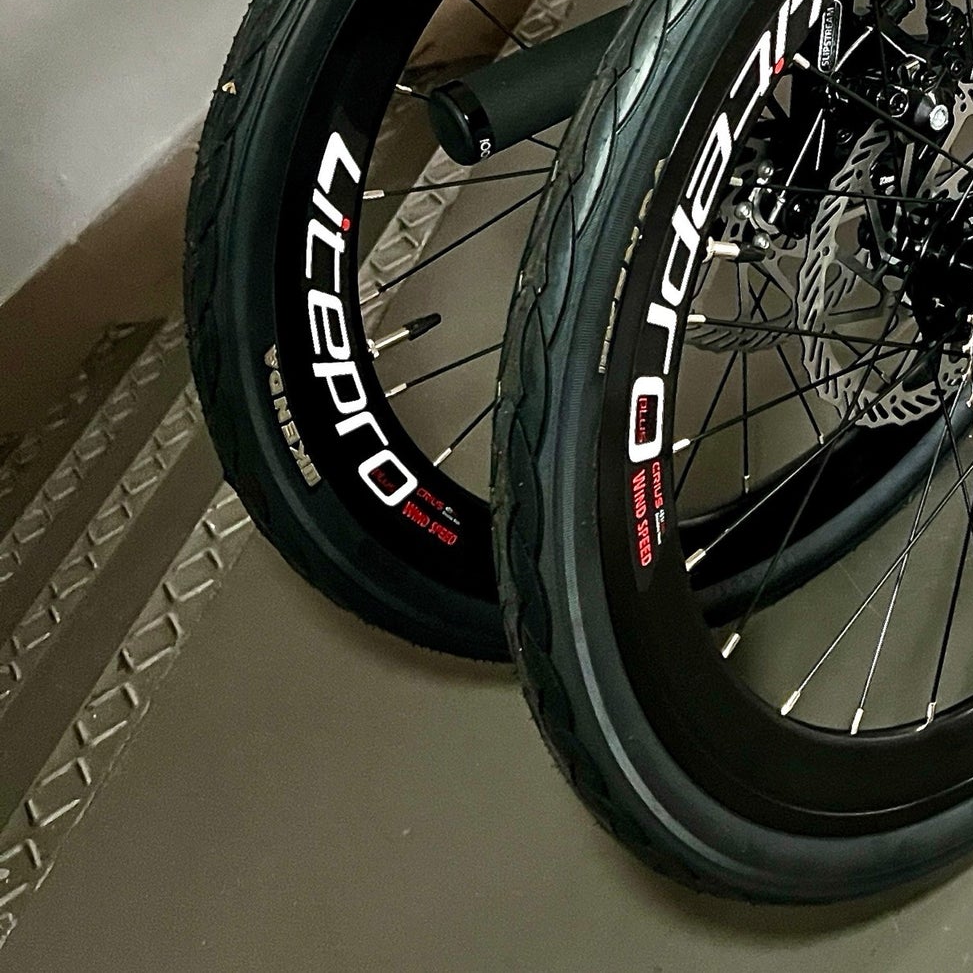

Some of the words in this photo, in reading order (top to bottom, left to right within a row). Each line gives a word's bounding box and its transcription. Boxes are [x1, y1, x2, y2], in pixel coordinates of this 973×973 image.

[821, 7, 834, 67] SLIPSTREAM
[264, 343, 312, 471] KENDA
[632, 469, 647, 519] WIND
[652, 462, 664, 509] CRIUS
[428, 521, 458, 545] SPEED
[638, 519, 653, 567] SPEED
